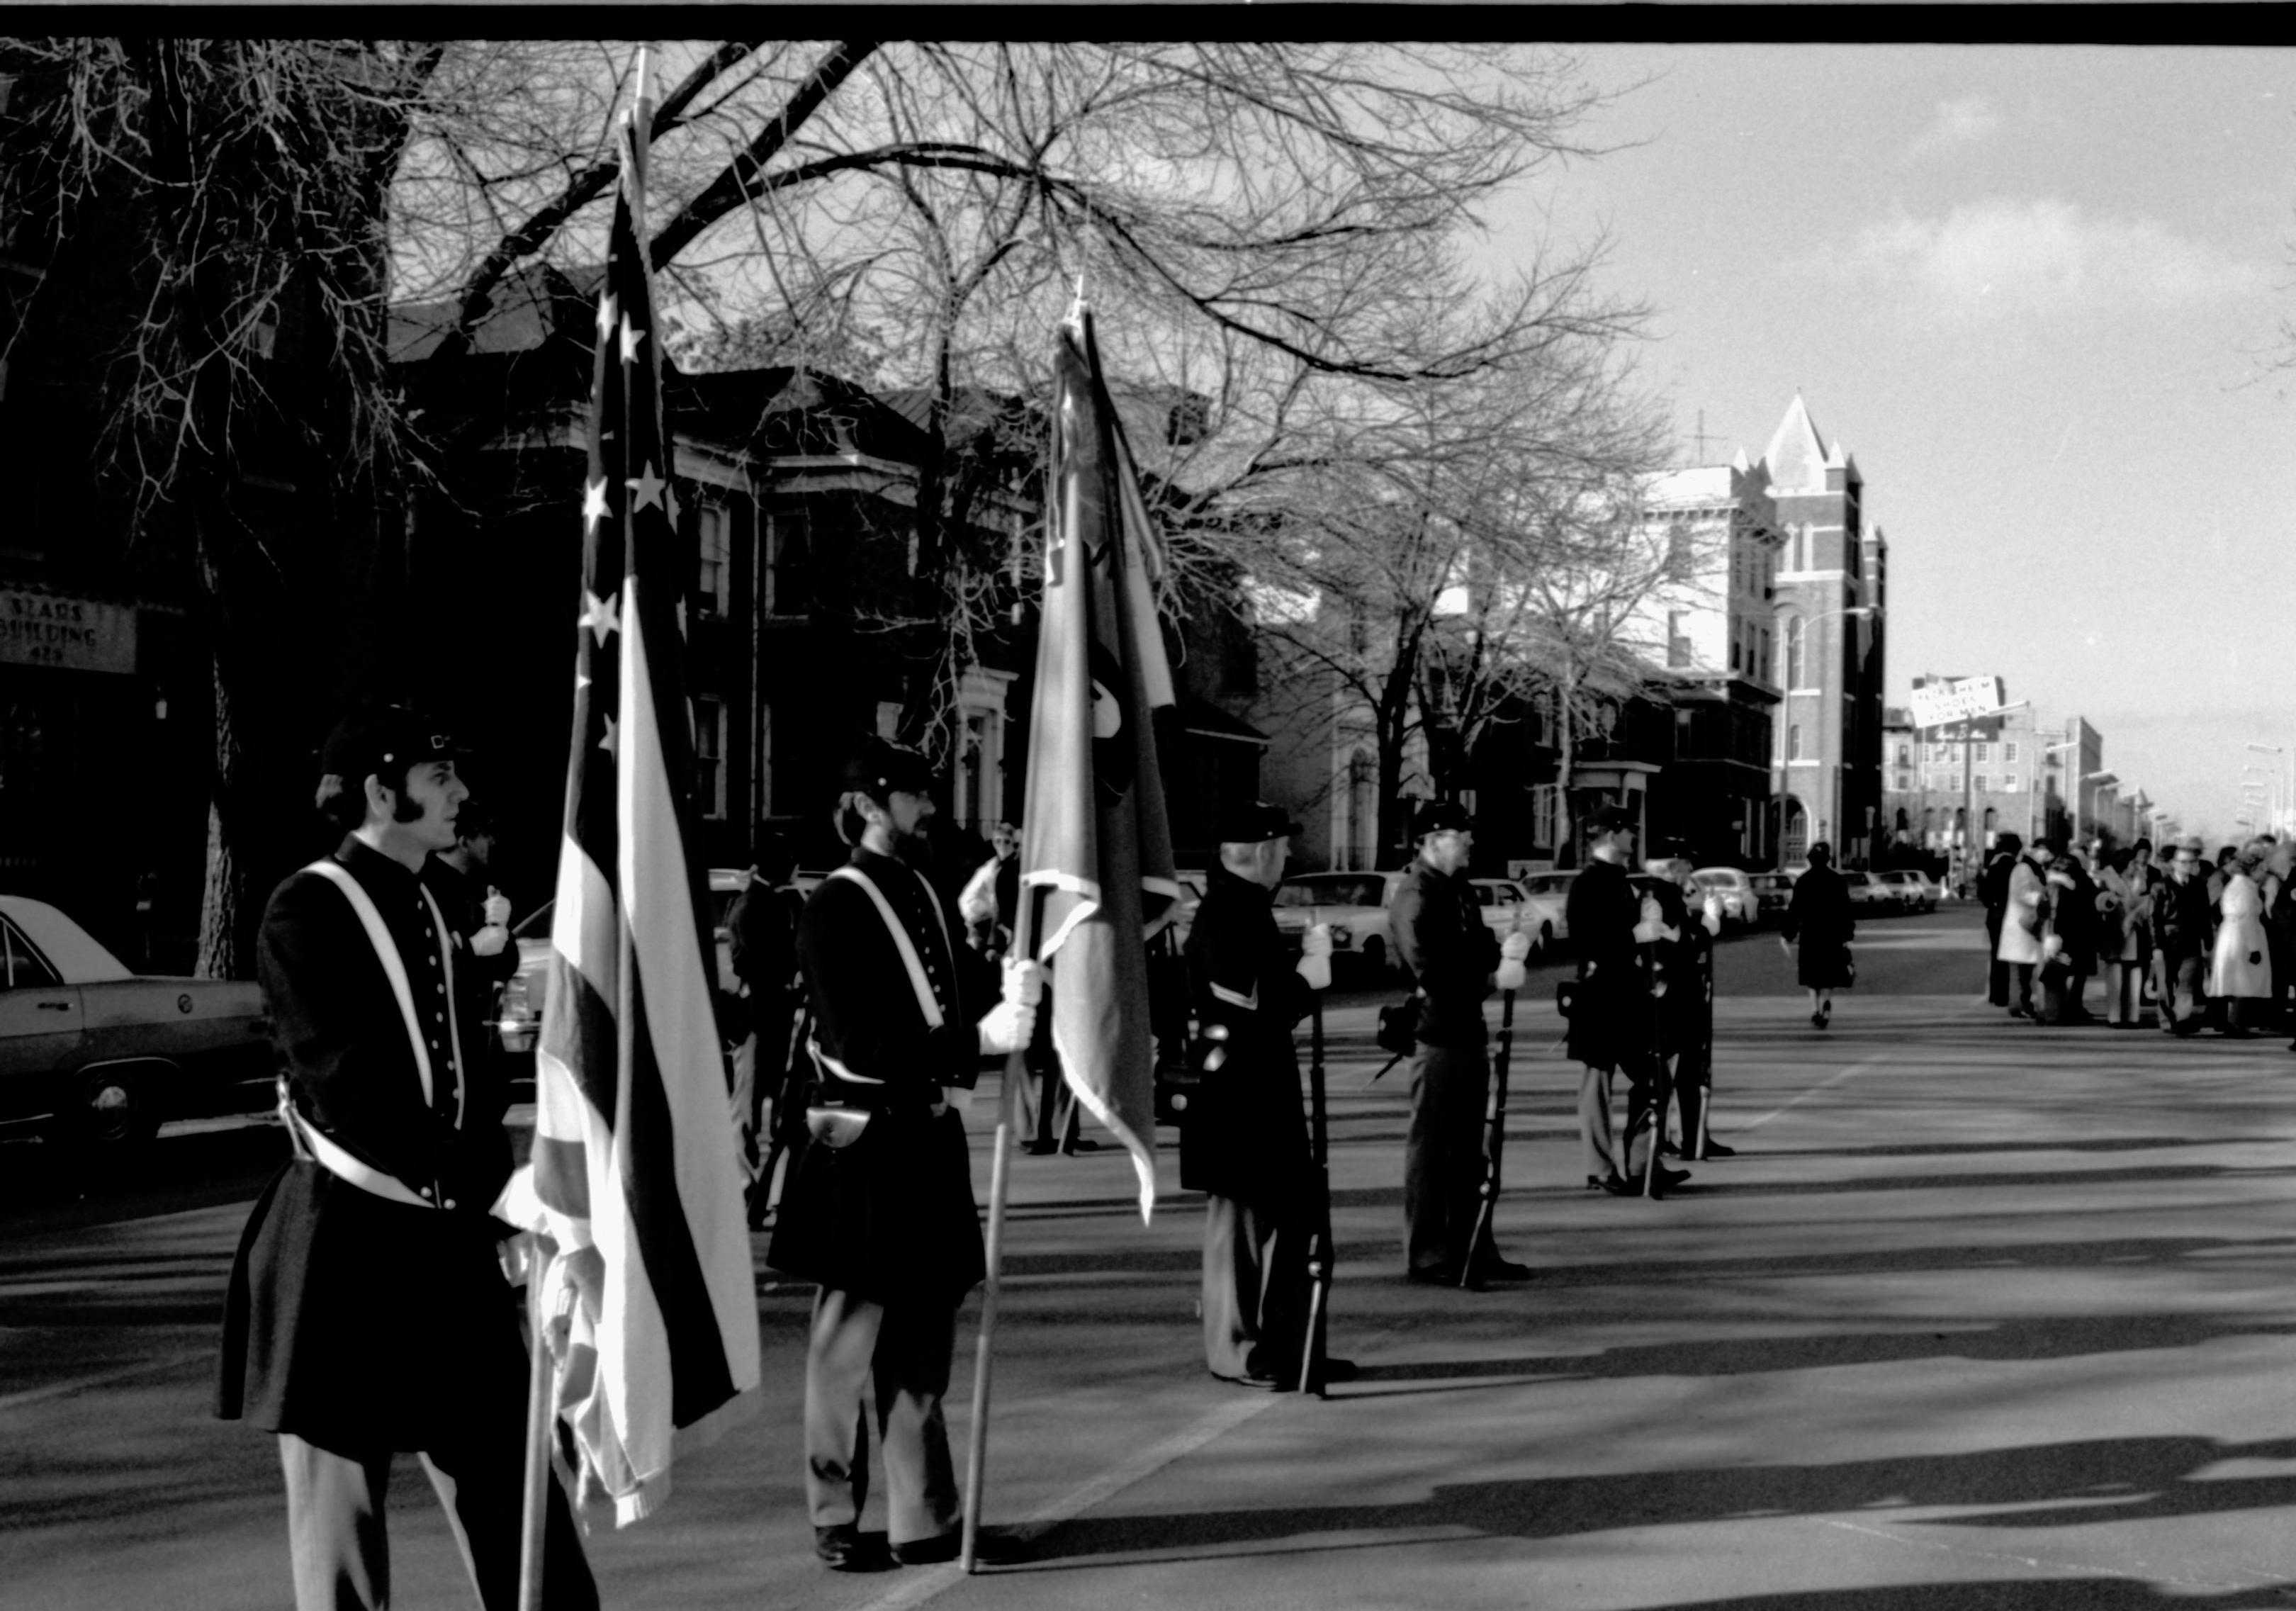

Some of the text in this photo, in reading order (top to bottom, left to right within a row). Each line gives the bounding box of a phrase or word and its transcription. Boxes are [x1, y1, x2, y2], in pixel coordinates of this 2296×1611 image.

[11, 597, 81, 623] SEARS
[1918, 680, 1991, 702] FLORHEIM
[1933, 695, 1976, 710] SHOES
[1928, 705, 1986, 721] FOR MEN
